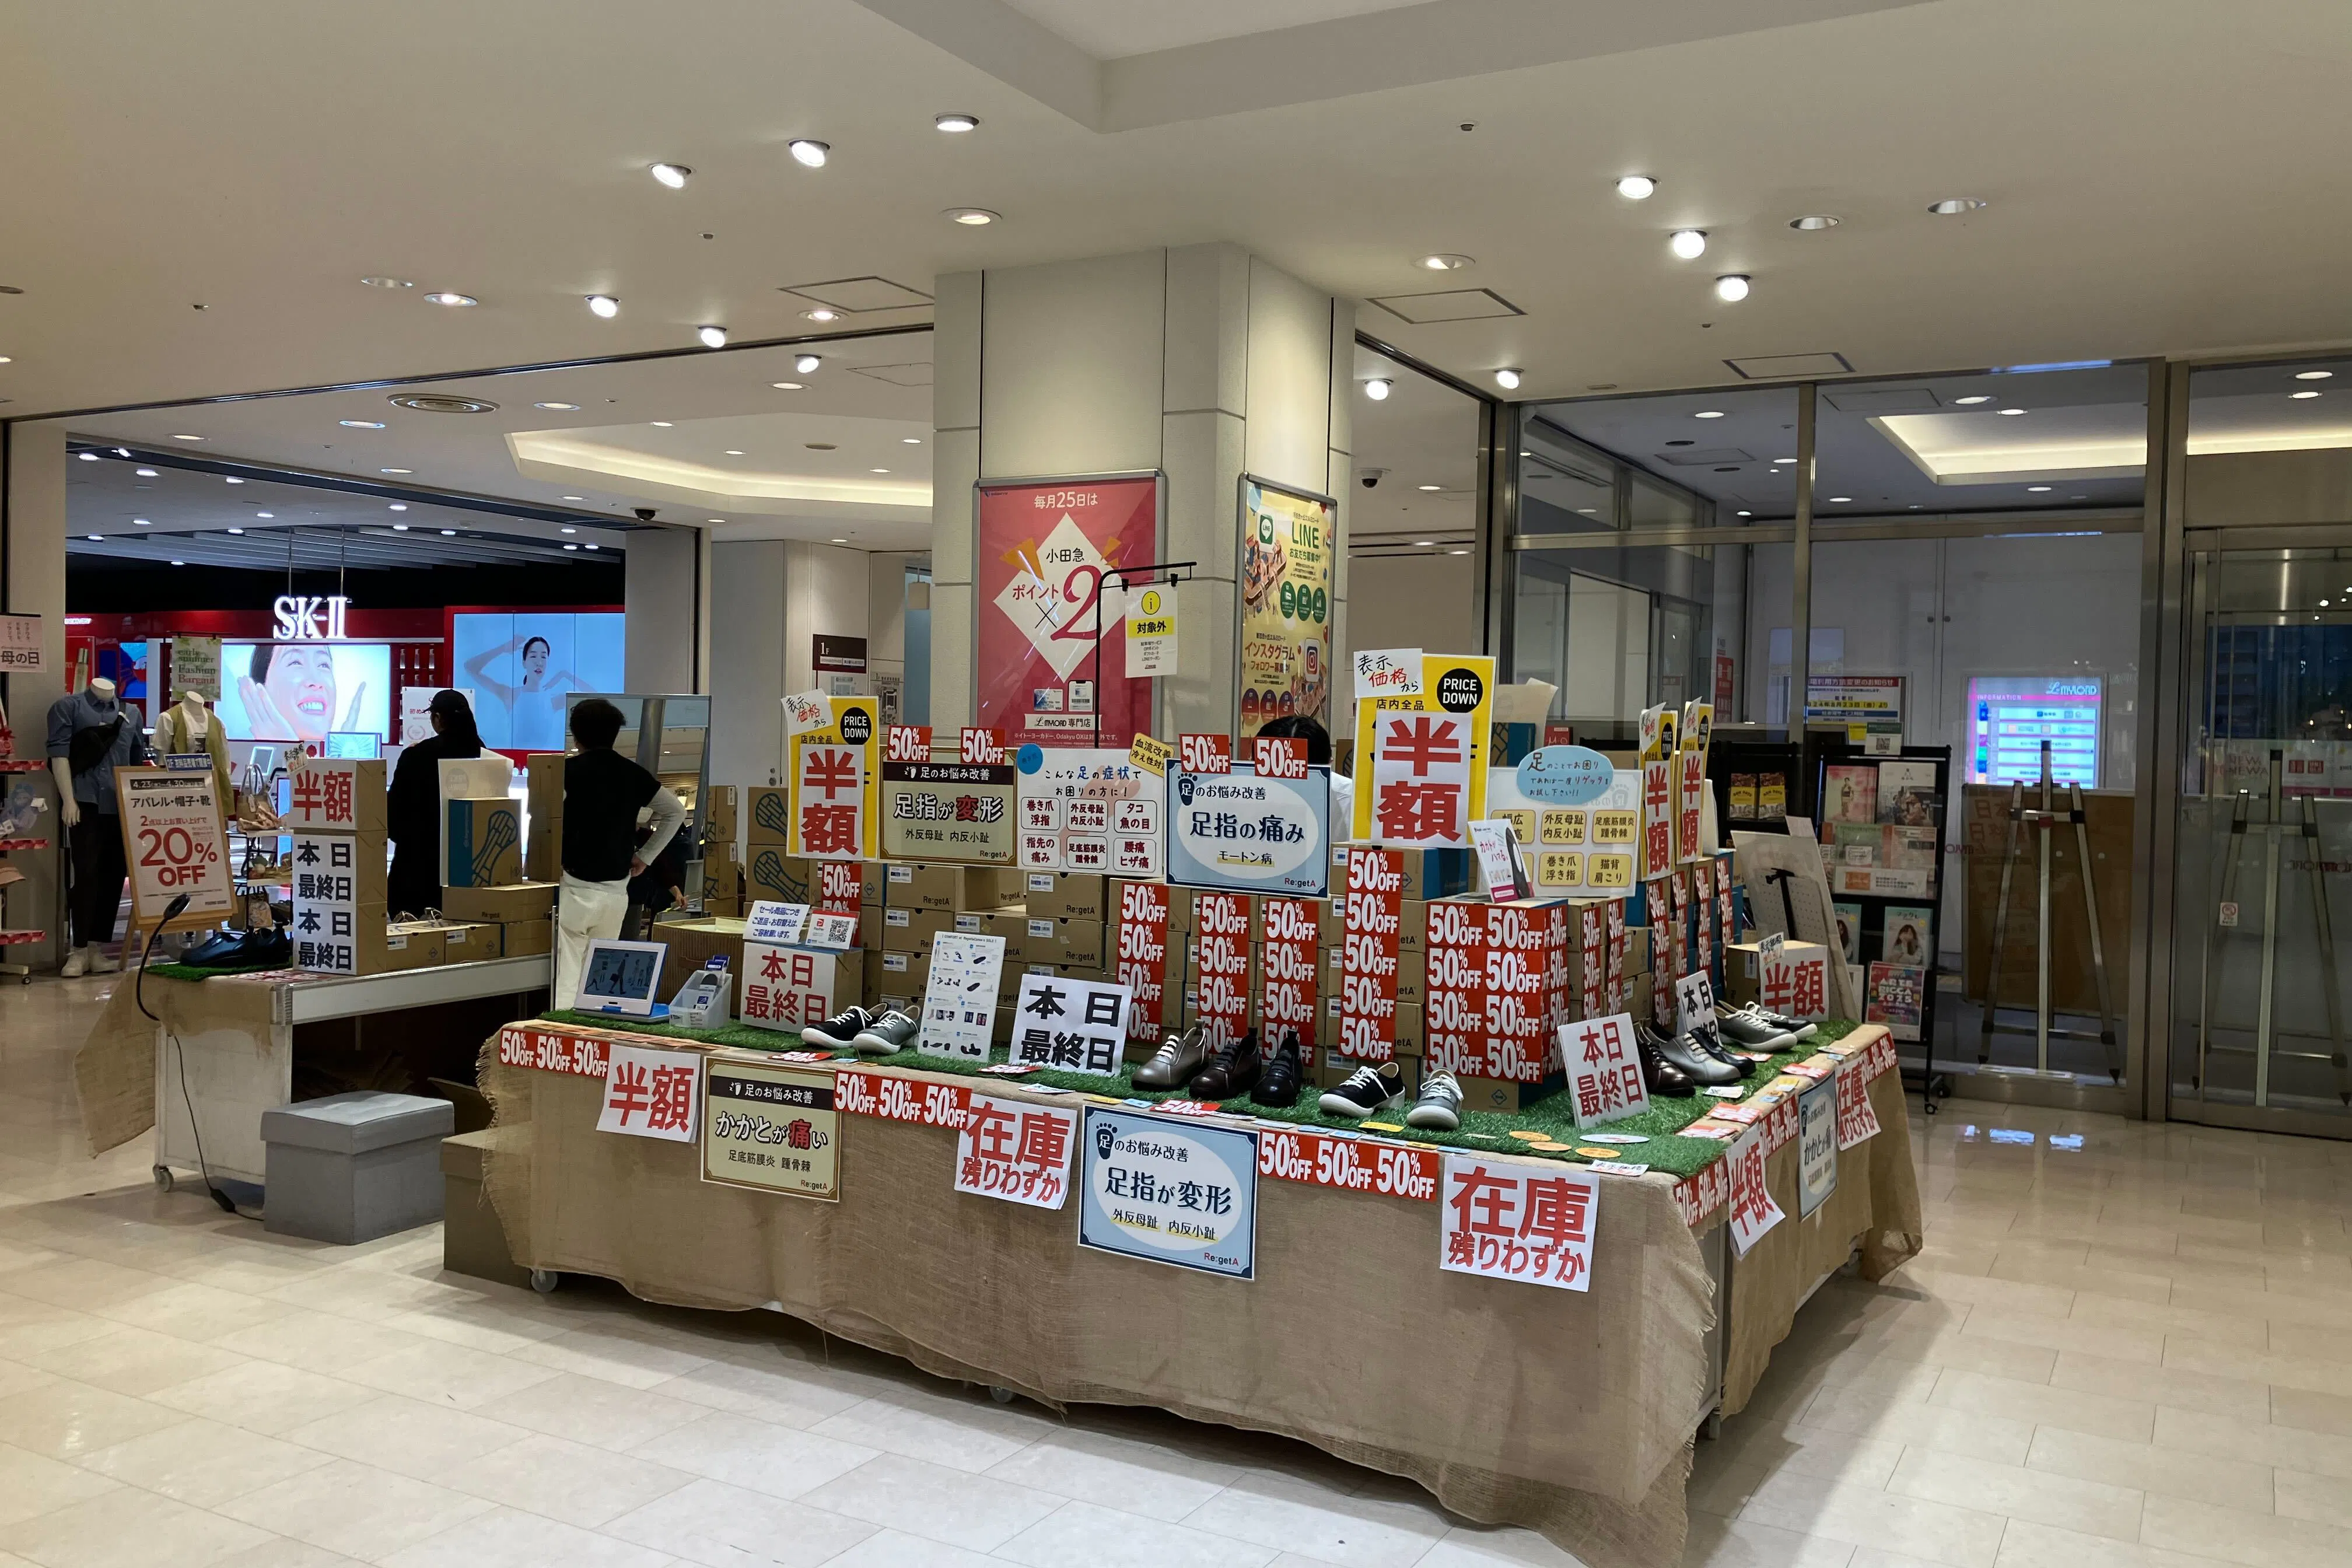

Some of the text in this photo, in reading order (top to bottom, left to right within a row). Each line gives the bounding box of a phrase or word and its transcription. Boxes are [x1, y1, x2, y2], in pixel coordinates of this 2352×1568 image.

[1034, 491, 1098, 509] 毎月25日は
[1293, 521, 1319, 549] LINE
[1046, 548, 1084, 563] 小田急
[1013, 584, 1059, 600] ポイント
[1137, 621, 1166, 634] 対象外
[0, 650, 40, 664] 母の日
[1245, 641, 1295, 661] インスタグラム
[178, 664, 216, 674] Fashion
[1358, 654, 1393, 676] 表示
[178, 674, 215, 685] Bargain
[1368, 668, 1407, 688] 価格
[1401, 681, 1419, 692] から
[1444, 678, 1477, 691] PRICE
[1376, 699, 1424, 710] 店内全品
[1443, 692, 1477, 705] DOWN
[845, 716, 867, 726] PRICE
[1068, 719, 1091, 727] 専門店
[801, 735, 833, 744] 店内全品
[845, 729, 868, 738] DOWN
[912, 746, 928, 761] OFF
[1527, 752, 1599, 772] 足のことでお困り
[921, 764, 990, 780] 足のお悩み改善
[1045, 765, 1141, 780] こんな足の症状で
[1209, 755, 1228, 772] OFF
[1377, 717, 1461, 841] 半額
[293, 770, 352, 822] 半額
[1181, 783, 1266, 800] 足のお悩み改善
[801, 749, 859, 855] 半額
[894, 793, 1004, 822] 足指が変形
[1027, 800, 1054, 811] 巻き爪
[1070, 803, 1104, 814] 外反母趾
[1127, 803, 1143, 814] タコ
[1682, 755, 1700, 857] 半額
[1031, 814, 1050, 826] 浮指
[1070, 816, 1104, 826] 内反小趾
[1120, 818, 1150, 830] 魚の目
[1190, 811, 1306, 844] 足指の痛み
[1545, 814, 1584, 825] 外反母趾
[1595, 817, 1634, 826] 足底筋膜炎
[1647, 765, 1670, 874] 半額
[905, 829, 989, 843] 外反母趾 内反小趾
[1544, 828, 1583, 839] 内反小趾
[138, 827, 217, 866] 20%
[1027, 837, 1055, 849] 指先の
[1124, 841, 1144, 853] 腰痛
[296, 841, 350, 867] 本日
[1031, 852, 1050, 863] 痛み
[1120, 856, 1149, 869] ヒザ痛
[1219, 850, 1273, 864] モートン病
[1547, 856, 1576, 866] 巻き爪
[1600, 859, 1619, 870] 猫背
[158, 865, 205, 887] OFF
[1284, 877, 1316, 888] Re:getA
[1377, 873, 1400, 892] OFF
[1546, 870, 1576, 881] 浮き指
[1594, 873, 1622, 883] 肩こり
[298, 875, 351, 901] 最終日
[844, 881, 860, 898] OFF
[923, 896, 950, 905] Re:getA
[1066, 905, 1095, 915] Re:getA
[1147, 905, 1166, 923] OFF
[299, 909, 351, 936] 本日
[1227, 915, 1247, 935] OFF
[1459, 927, 1482, 947] OFF
[298, 943, 352, 970] 最終日
[1066, 951, 1095, 961] Re:getA
[761, 950, 813, 989] 本日
[1458, 970, 1482, 989] OFF
[1765, 961, 1825, 1017] 半額
[745, 985, 826, 1026] 最終日
[1025, 985, 1122, 1027] 本日
[1684, 980, 1712, 1017] 本日
[1020, 1028, 1116, 1072] 最終日
[1580, 1021, 1623, 1068] 本日
[555, 1055, 570, 1072] OFF
[609, 1062, 694, 1133] 半額
[744, 1084, 813, 1104] 足のお悩み改善
[1577, 1064, 1643, 1118] 最終日
[1838, 1060, 1867, 1118] 在庫
[858, 1094, 876, 1114] OFF
[947, 1106, 967, 1128] OFF
[715, 1111, 828, 1150] かかとが痛い
[967, 1101, 1070, 1171] 在庫
[1098, 1135, 1189, 1163] 足のお悩み改善
[728, 1149, 775, 1168] 足底筋膜炎
[801, 1180, 828, 1191] Re:getA
[961, 1157, 1061, 1202] 残りわずか
[1348, 1167, 1372, 1190] OFF
[1105, 1167, 1232, 1216] 足指が変形
[1731, 1141, 1774, 1236] 半額
[1450, 1166, 1591, 1247] 在庫
[1112, 1208, 1216, 1241] 外反母趾 内反小趾
[1203, 1252, 1239, 1267] Re:getA
[1448, 1231, 1586, 1284] 残りわずか
